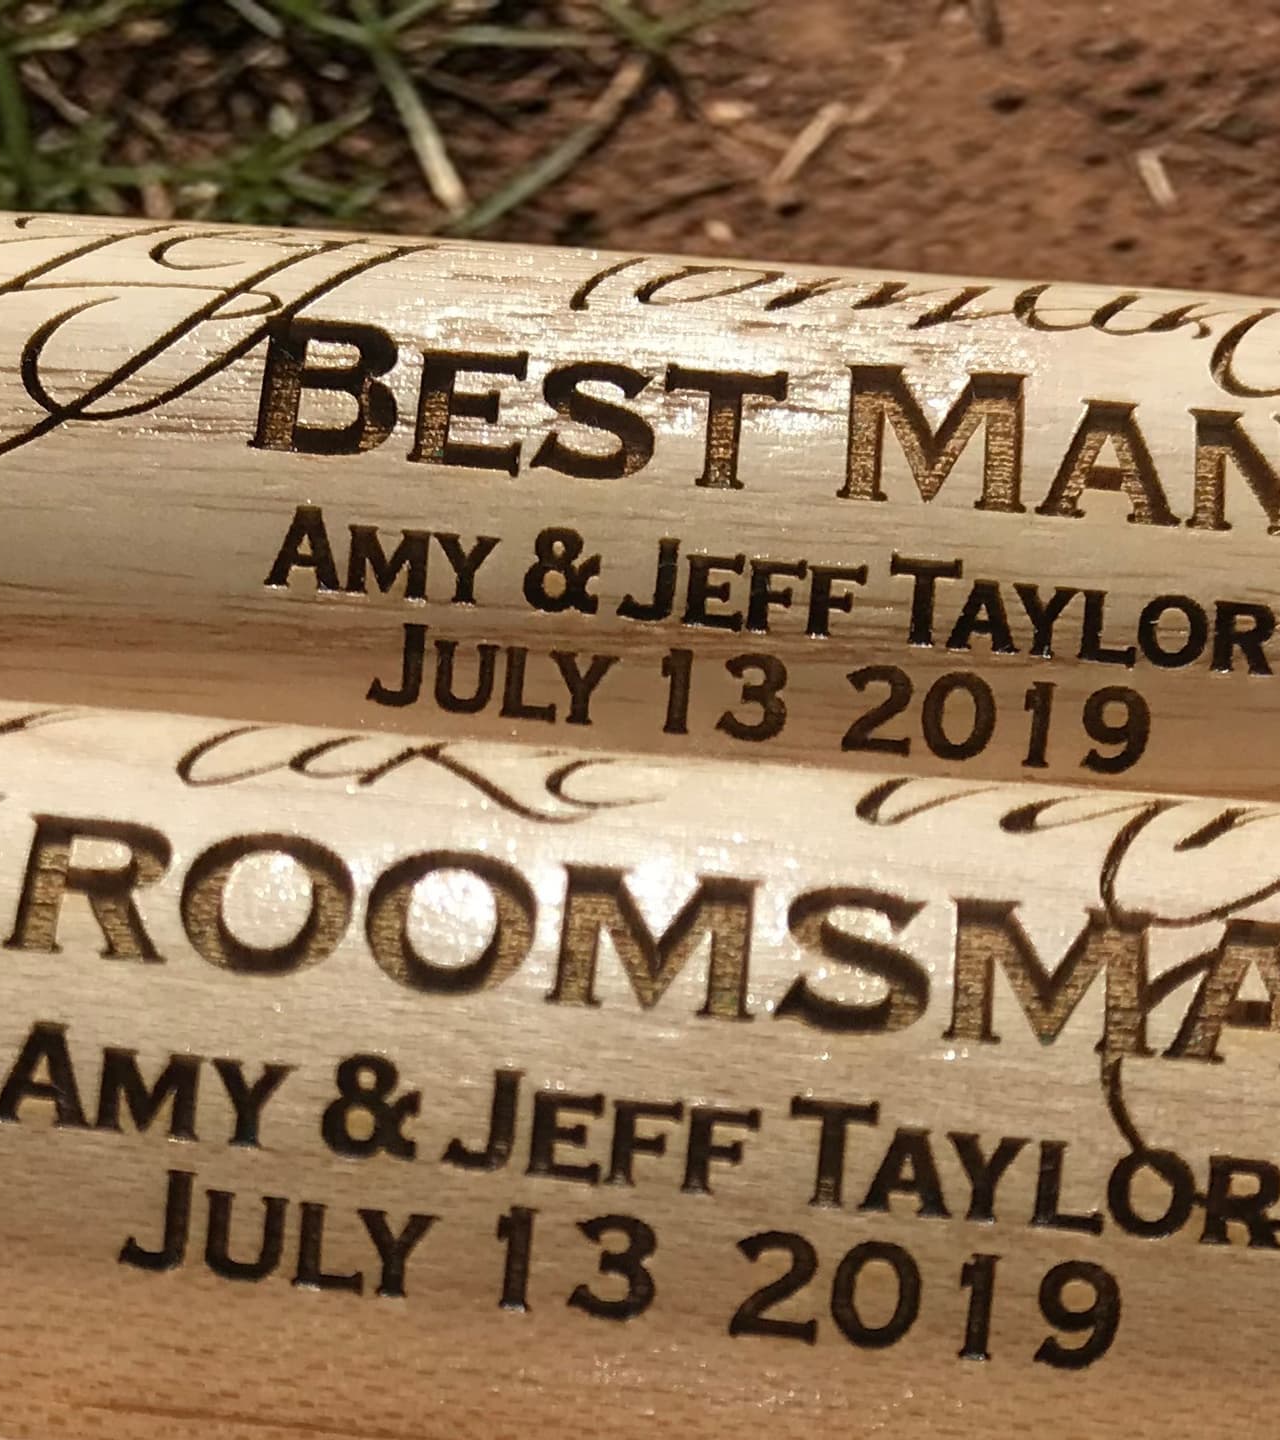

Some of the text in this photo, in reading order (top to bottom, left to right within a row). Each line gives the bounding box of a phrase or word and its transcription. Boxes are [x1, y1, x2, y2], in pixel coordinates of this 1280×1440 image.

[247, 314, 790, 491] BEST
[262, 504, 1278, 676] AMY & JEFF TAYLOR
[366, 622, 1152, 775] JULY 13 2019
[319, 1052, 422, 1161] &
[440, 1068, 762, 1196] JEFF
[120, 1169, 1123, 1370] JULY 13 2019
